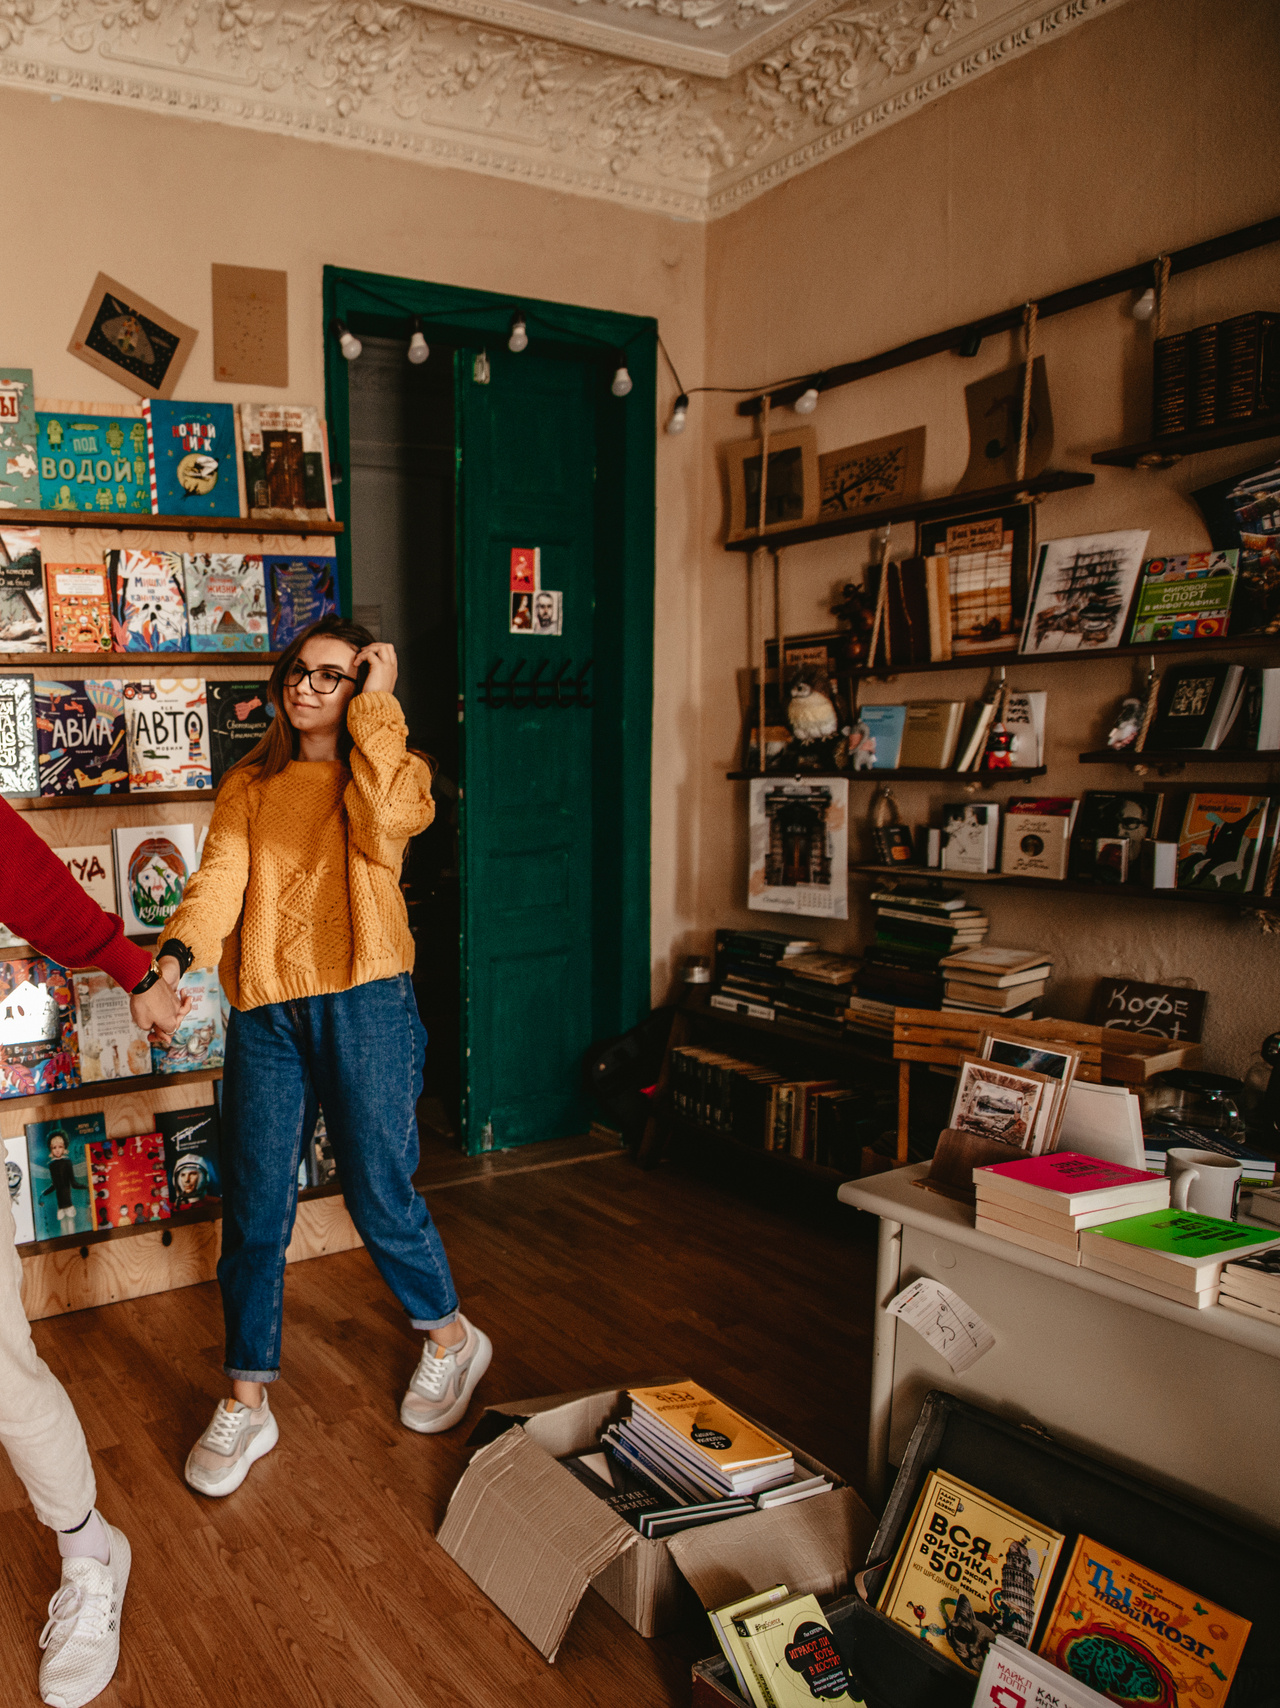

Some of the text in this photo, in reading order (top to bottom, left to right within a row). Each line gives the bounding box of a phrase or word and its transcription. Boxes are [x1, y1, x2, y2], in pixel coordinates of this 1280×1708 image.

[172, 422, 216, 438] НОЧНОЙ
[73, 436, 98, 452] ПОД
[182, 435, 212, 452] ЦИРК
[41, 456, 132, 484] ВОДОЙ
[206, 585, 237, 594] ЖИЗНИ
[1162, 590, 1206, 604] СПОРТ
[1163, 583, 1208, 595] МИРОВОЙ
[1144, 604, 1151, 612] В
[52, 718, 114, 749] АВИА
[135, 711, 203, 745] АВТО
[655, 1390, 696, 1403] РЕЧЬ
[939, 1490, 957, 1503] АДАМ
[928, 1512, 992, 1554] ВСЯ
[919, 1544, 988, 1586] В 50 ЭКСПЕ
[923, 1532, 994, 1581] ФИЗИКА
[912, 1562, 960, 1595] КОТ ШРЁДИНГЕРА
[962, 1574, 973, 1586] РИ
[959, 1582, 987, 1602] МЕНТАХ
[1086, 1559, 1170, 1622] Ты это
[1093, 1586, 1145, 1625] твой
[788, 1636, 830, 1660] ИГРАЮТ ЛИ
[814, 1647, 836, 1662] КОТЫ
[808, 1665, 816, 1676] В
[997, 1662, 1033, 1692] МАЙКЛ
[998, 1672, 1028, 1695] ЛОПП
